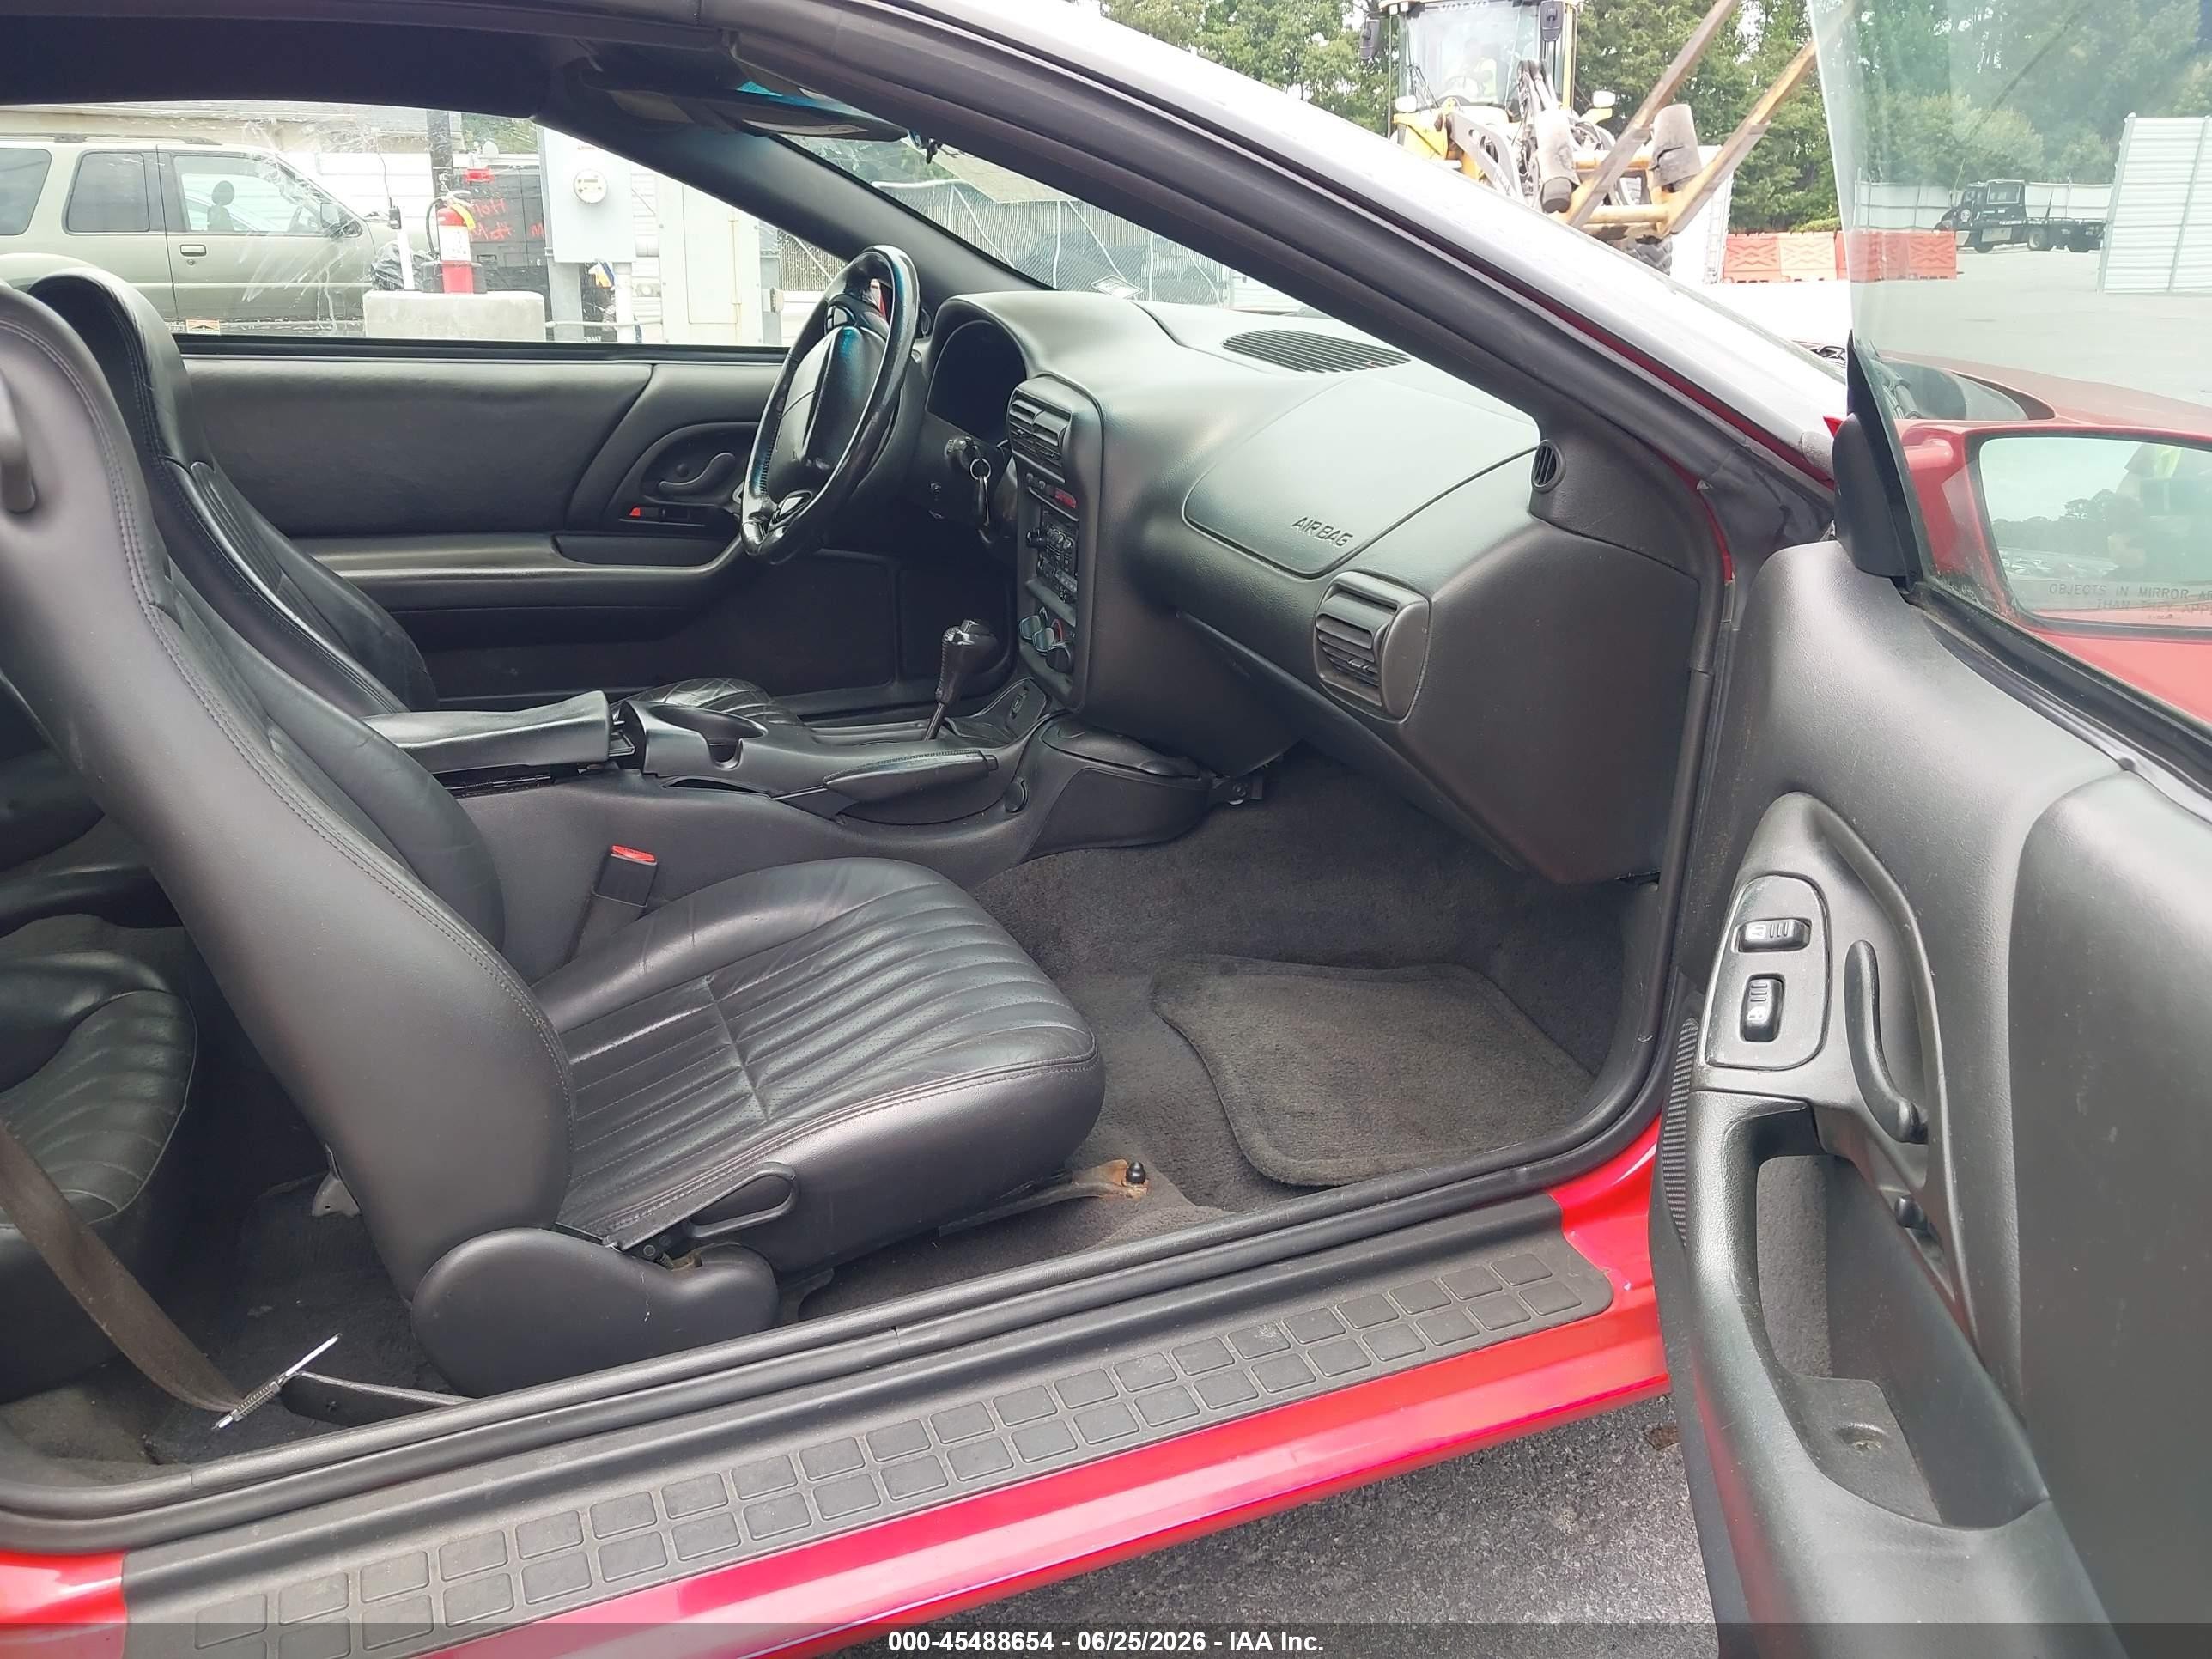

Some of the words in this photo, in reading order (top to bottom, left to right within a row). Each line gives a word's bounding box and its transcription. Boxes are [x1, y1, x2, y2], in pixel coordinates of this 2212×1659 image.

[1291, 516, 1354, 547] AIRBAG
[2049, 583, 2107, 596] OBJECTS
[2116, 585, 2130, 596] IN
[2139, 586, 2189, 599] MIRROR
